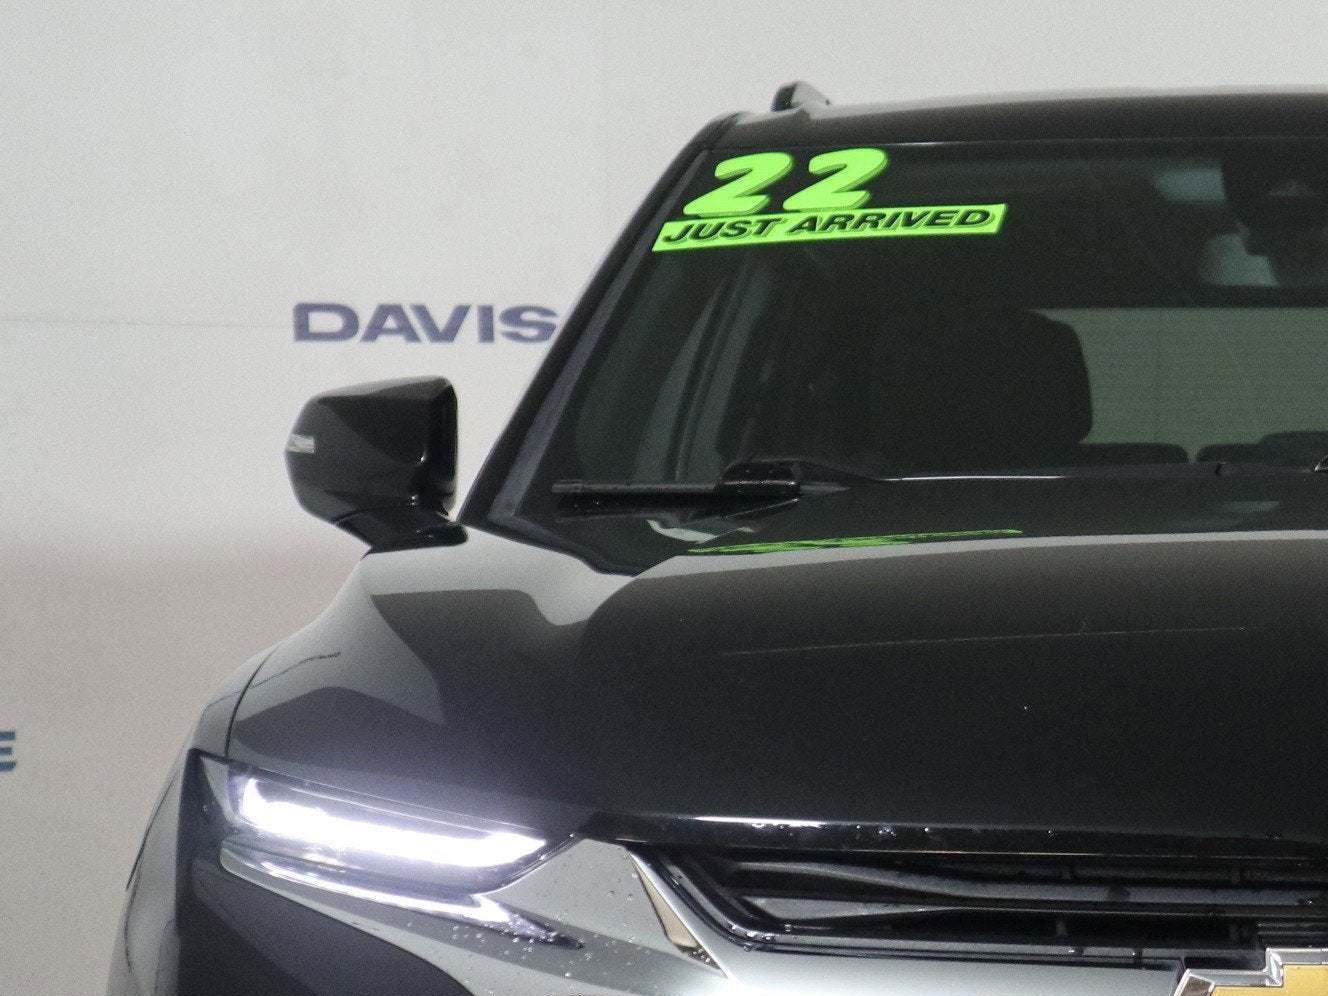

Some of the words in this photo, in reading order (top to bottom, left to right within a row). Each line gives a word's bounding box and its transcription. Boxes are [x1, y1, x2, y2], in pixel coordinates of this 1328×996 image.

[682, 148, 889, 217] 22
[663, 216, 785, 244] JUST
[787, 207, 993, 234] ARRIVED
[293, 302, 559, 343] DAVIS
